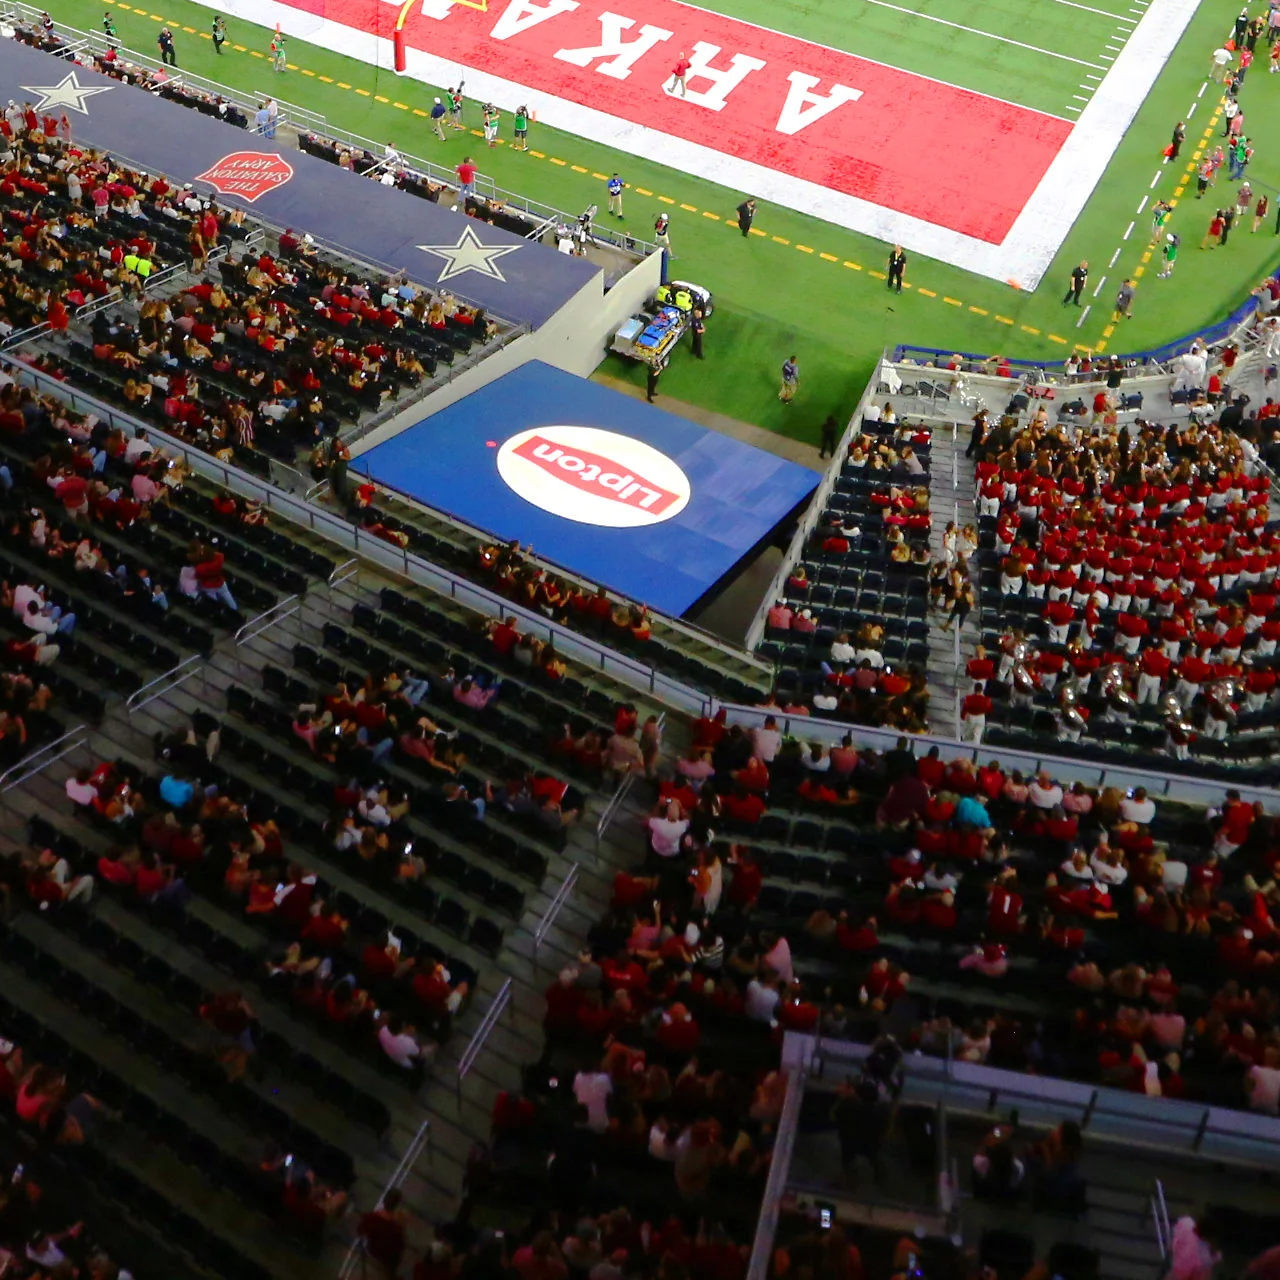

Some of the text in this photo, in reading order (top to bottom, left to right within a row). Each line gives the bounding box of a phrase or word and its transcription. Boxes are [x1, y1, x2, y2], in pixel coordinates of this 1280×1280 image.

[223, 158, 280, 169] ARMY
[205, 169, 290, 182] SALVATION
[223, 181, 261, 192] THE
[532, 443, 662, 509] Lipton
